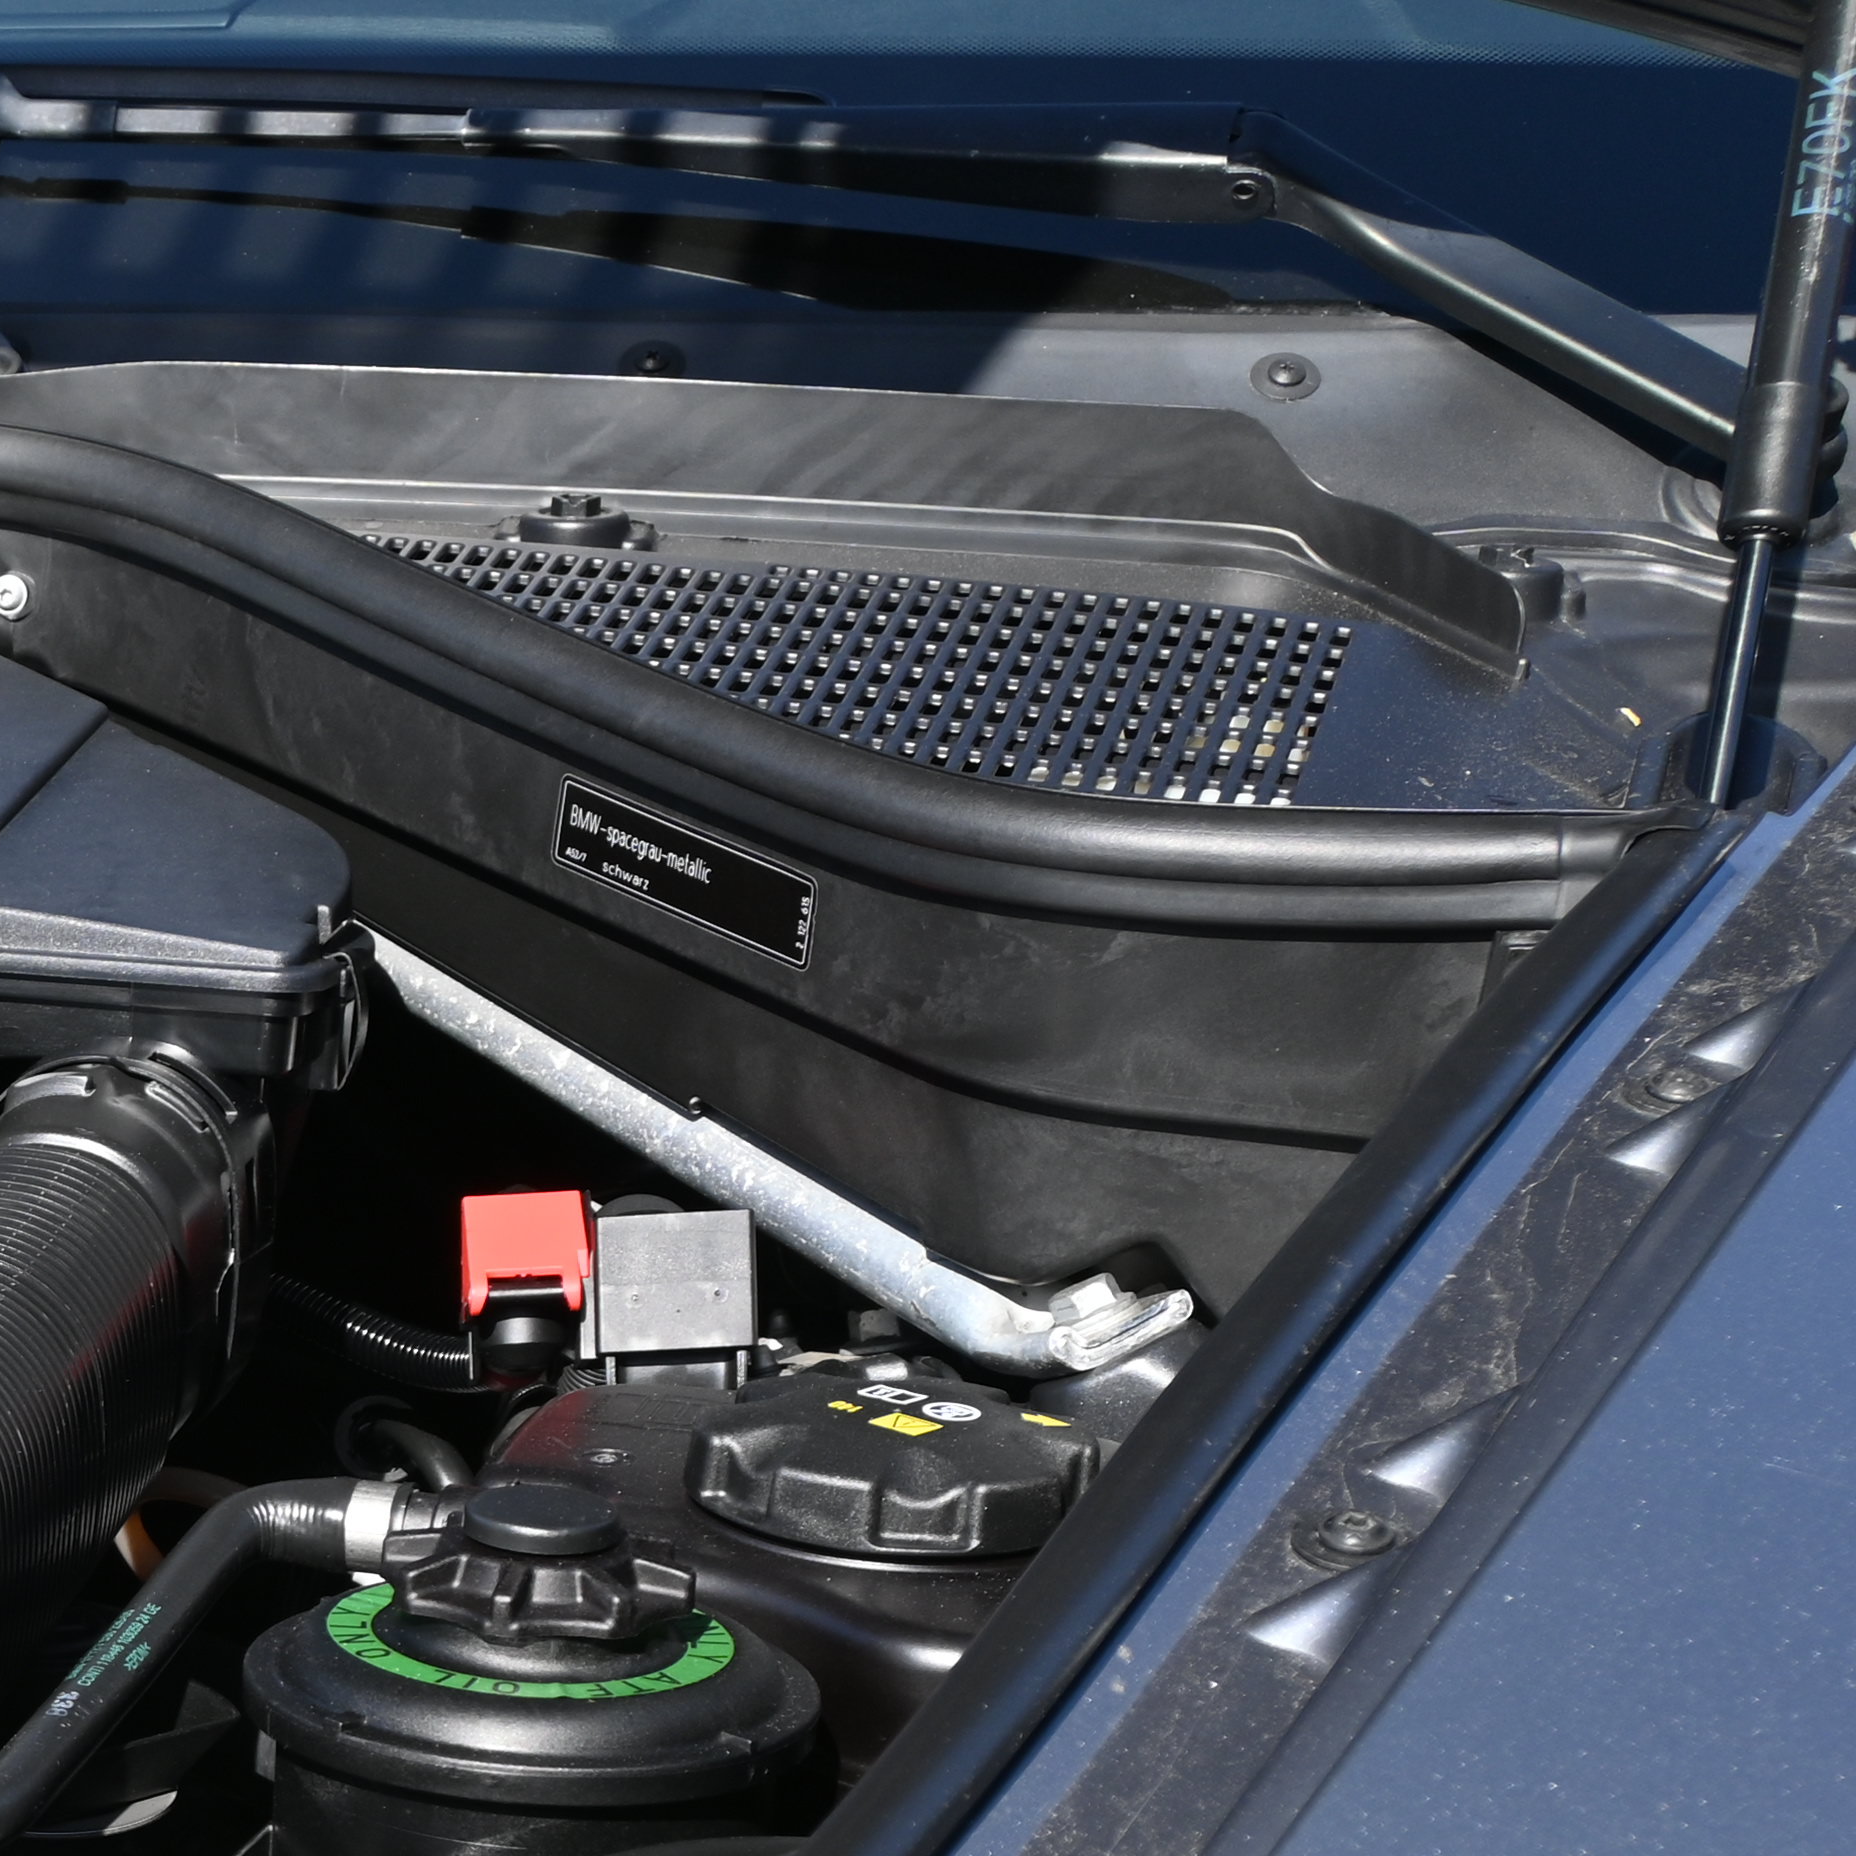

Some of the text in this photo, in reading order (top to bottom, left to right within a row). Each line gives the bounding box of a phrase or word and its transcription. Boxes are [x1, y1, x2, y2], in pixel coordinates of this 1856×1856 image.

[569, 803, 712, 884] BMW-spacegrau-metallic
[602, 861, 650, 891] schwarz
[329, 1606, 392, 1659] ONLY
[434, 1669, 521, 1694] OIL
[586, 1671, 683, 1698] ATF
